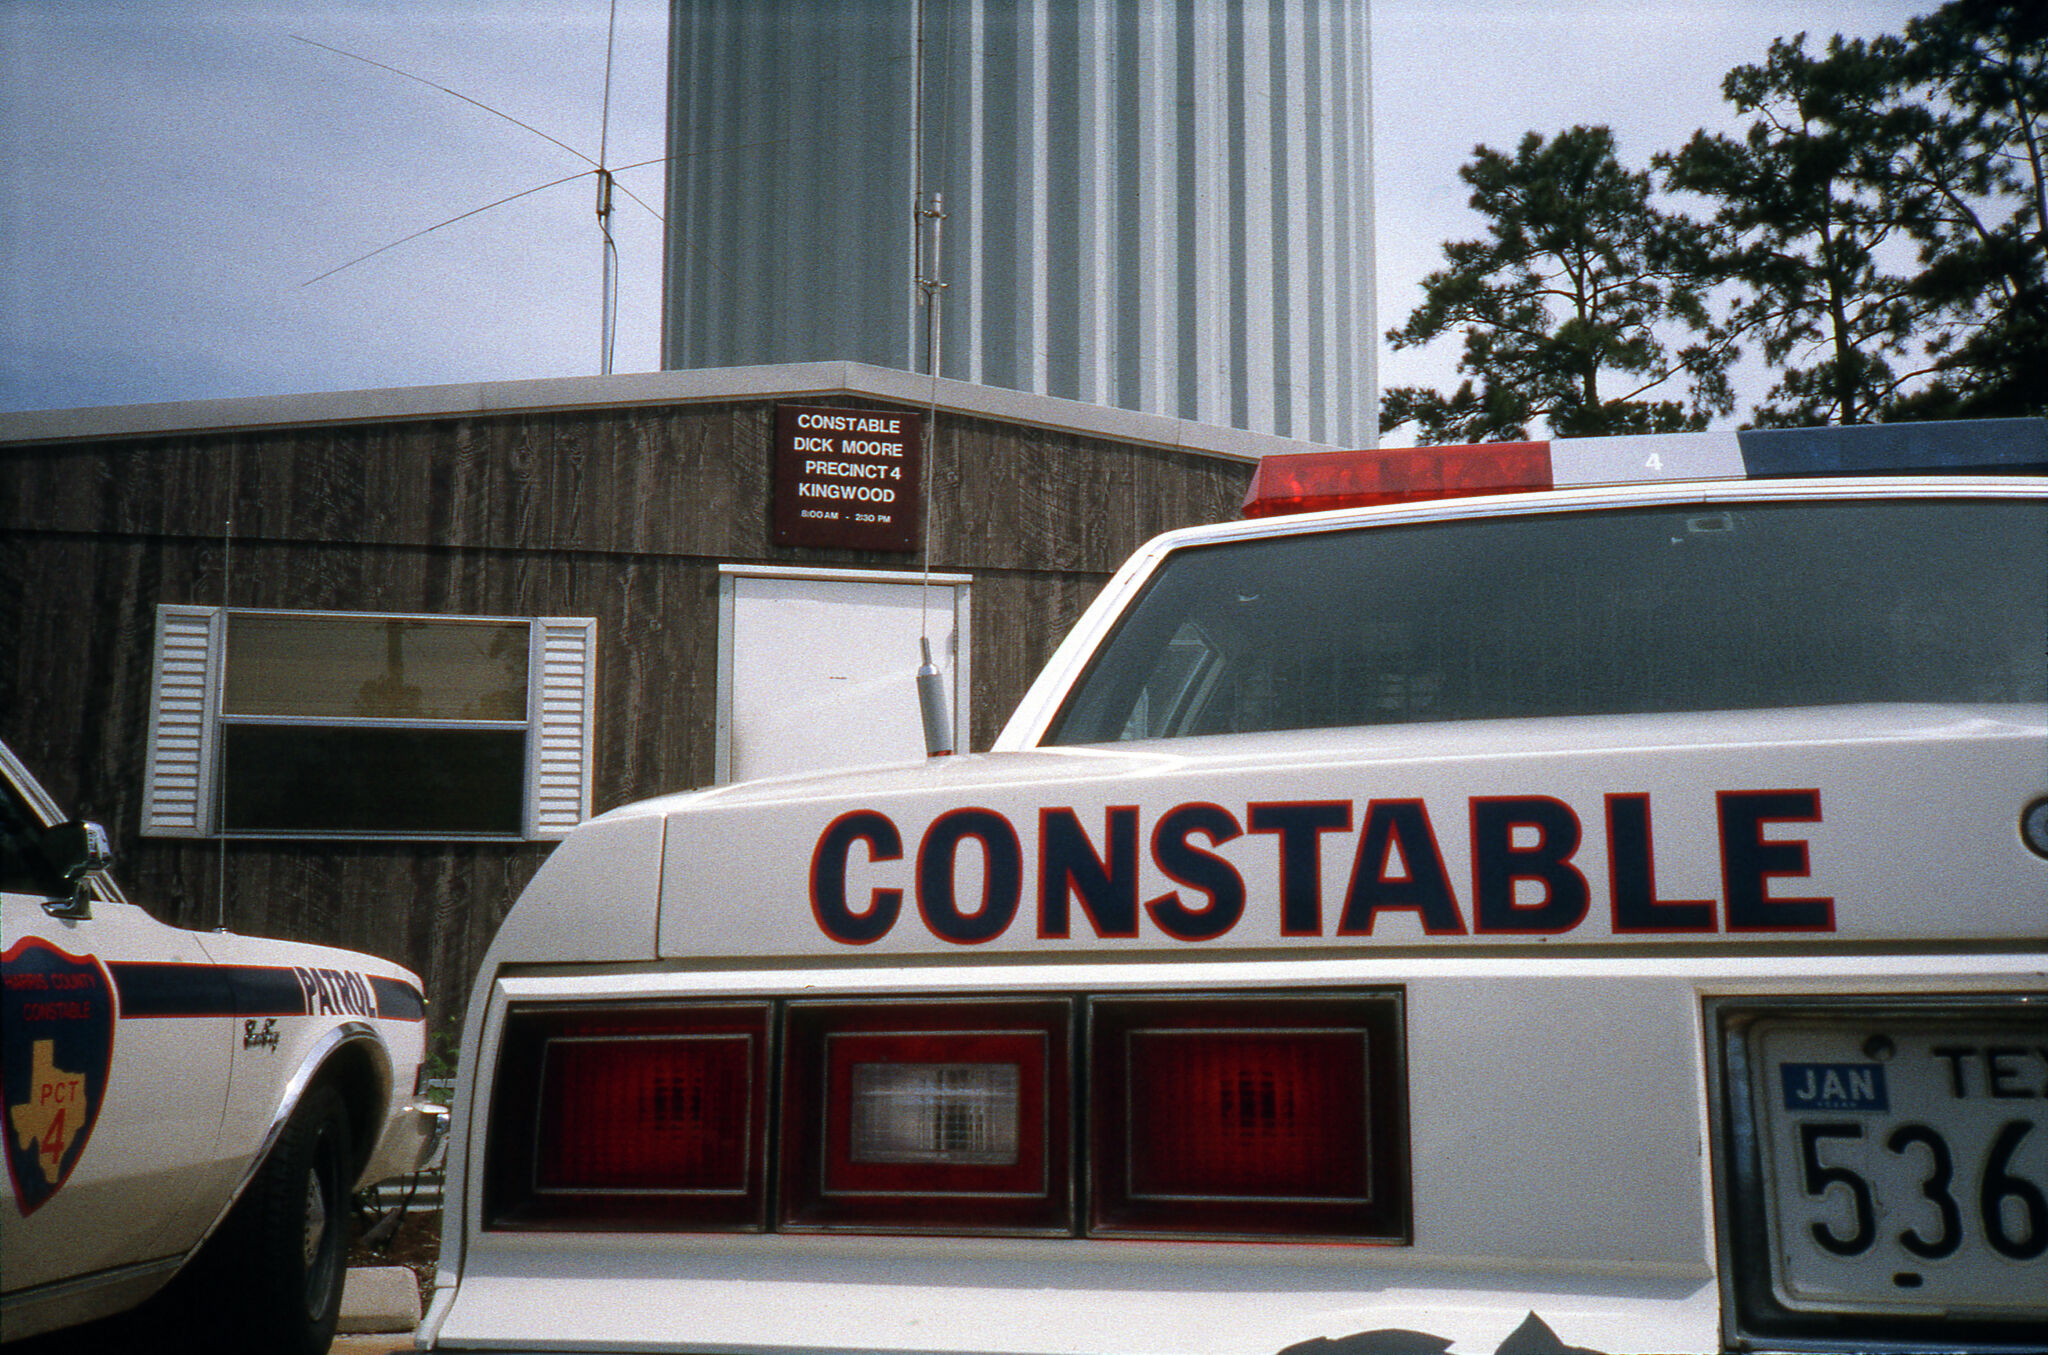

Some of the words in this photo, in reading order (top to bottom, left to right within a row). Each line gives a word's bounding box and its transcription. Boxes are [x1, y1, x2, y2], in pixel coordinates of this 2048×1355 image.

[797, 414, 901, 434] CONSTABLE
[793, 436, 834, 452] DICK
[841, 439, 904, 457] MOORE
[805, 460, 889, 479] PRECINCT
[889, 466, 902, 480] 4
[1645, 452, 1664, 471] 4
[798, 482, 896, 503] KINGWOOD
[823, 511, 839, 520] AM
[855, 513, 876, 523] 2:30
[877, 514, 892, 524] PM
[808, 788, 1837, 946] CONSTABLE
[50, 972, 97, 991] COUNTY
[295, 966, 377, 1018] PATROL
[23, 1000, 92, 1022] CONSTABLE
[1932, 1045, 2048, 1099] TE
[40, 1081, 80, 1106] PCT
[1796, 1068, 1876, 1101] JAN
[40, 1108, 66, 1165] 4
[1800, 1120, 2048, 1261] 536
